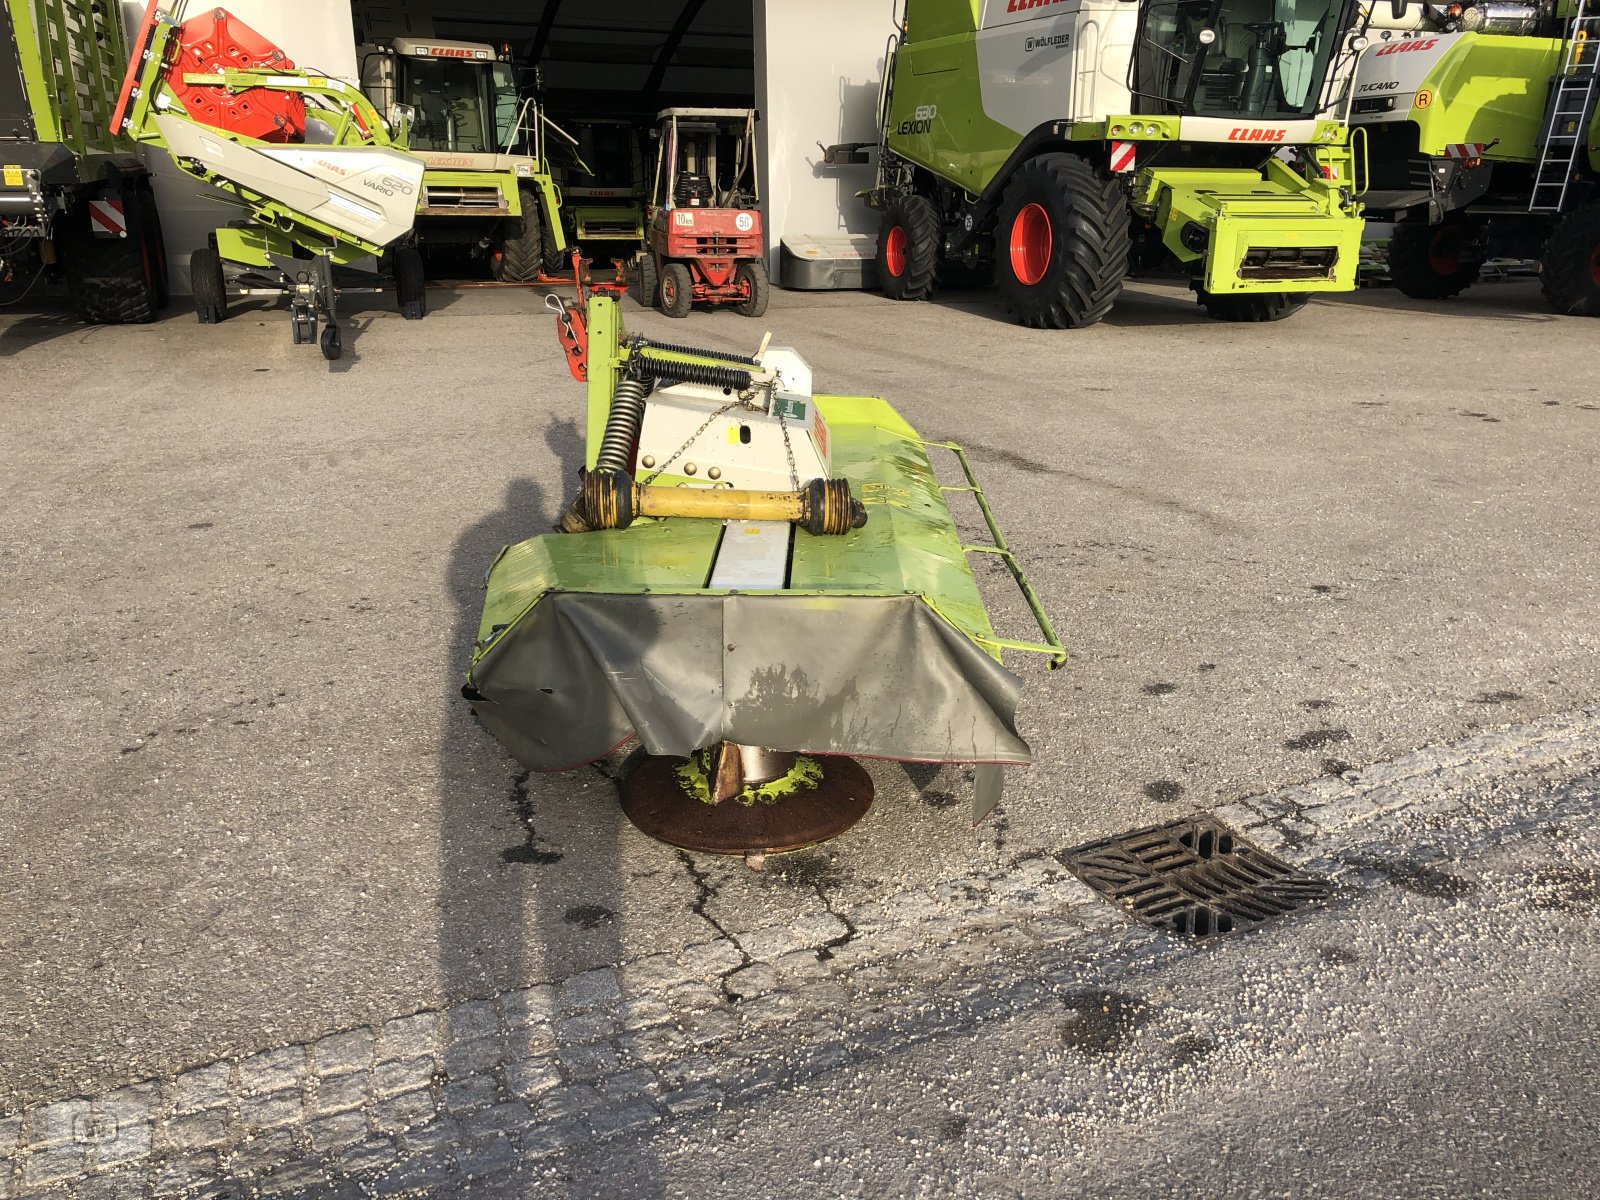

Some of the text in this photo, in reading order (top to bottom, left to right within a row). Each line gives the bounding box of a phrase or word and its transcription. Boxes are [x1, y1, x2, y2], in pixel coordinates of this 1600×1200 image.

[1035, 34, 1069, 48] WÖLFLEDER
[1375, 39, 1439, 56] CLAAS
[431, 48, 473, 57] CLAAS
[1358, 81, 1399, 92] TUCANO
[1418, 93, 1427, 105] R
[915, 104, 937, 120] 630
[897, 119, 931, 135] LEXION
[1228, 128, 1287, 141] CLAAS
[363, 178, 394, 197] VARIO
[381, 176, 413, 196] 620
[677, 213, 685, 224] 10
[739, 216, 750, 228] 50
